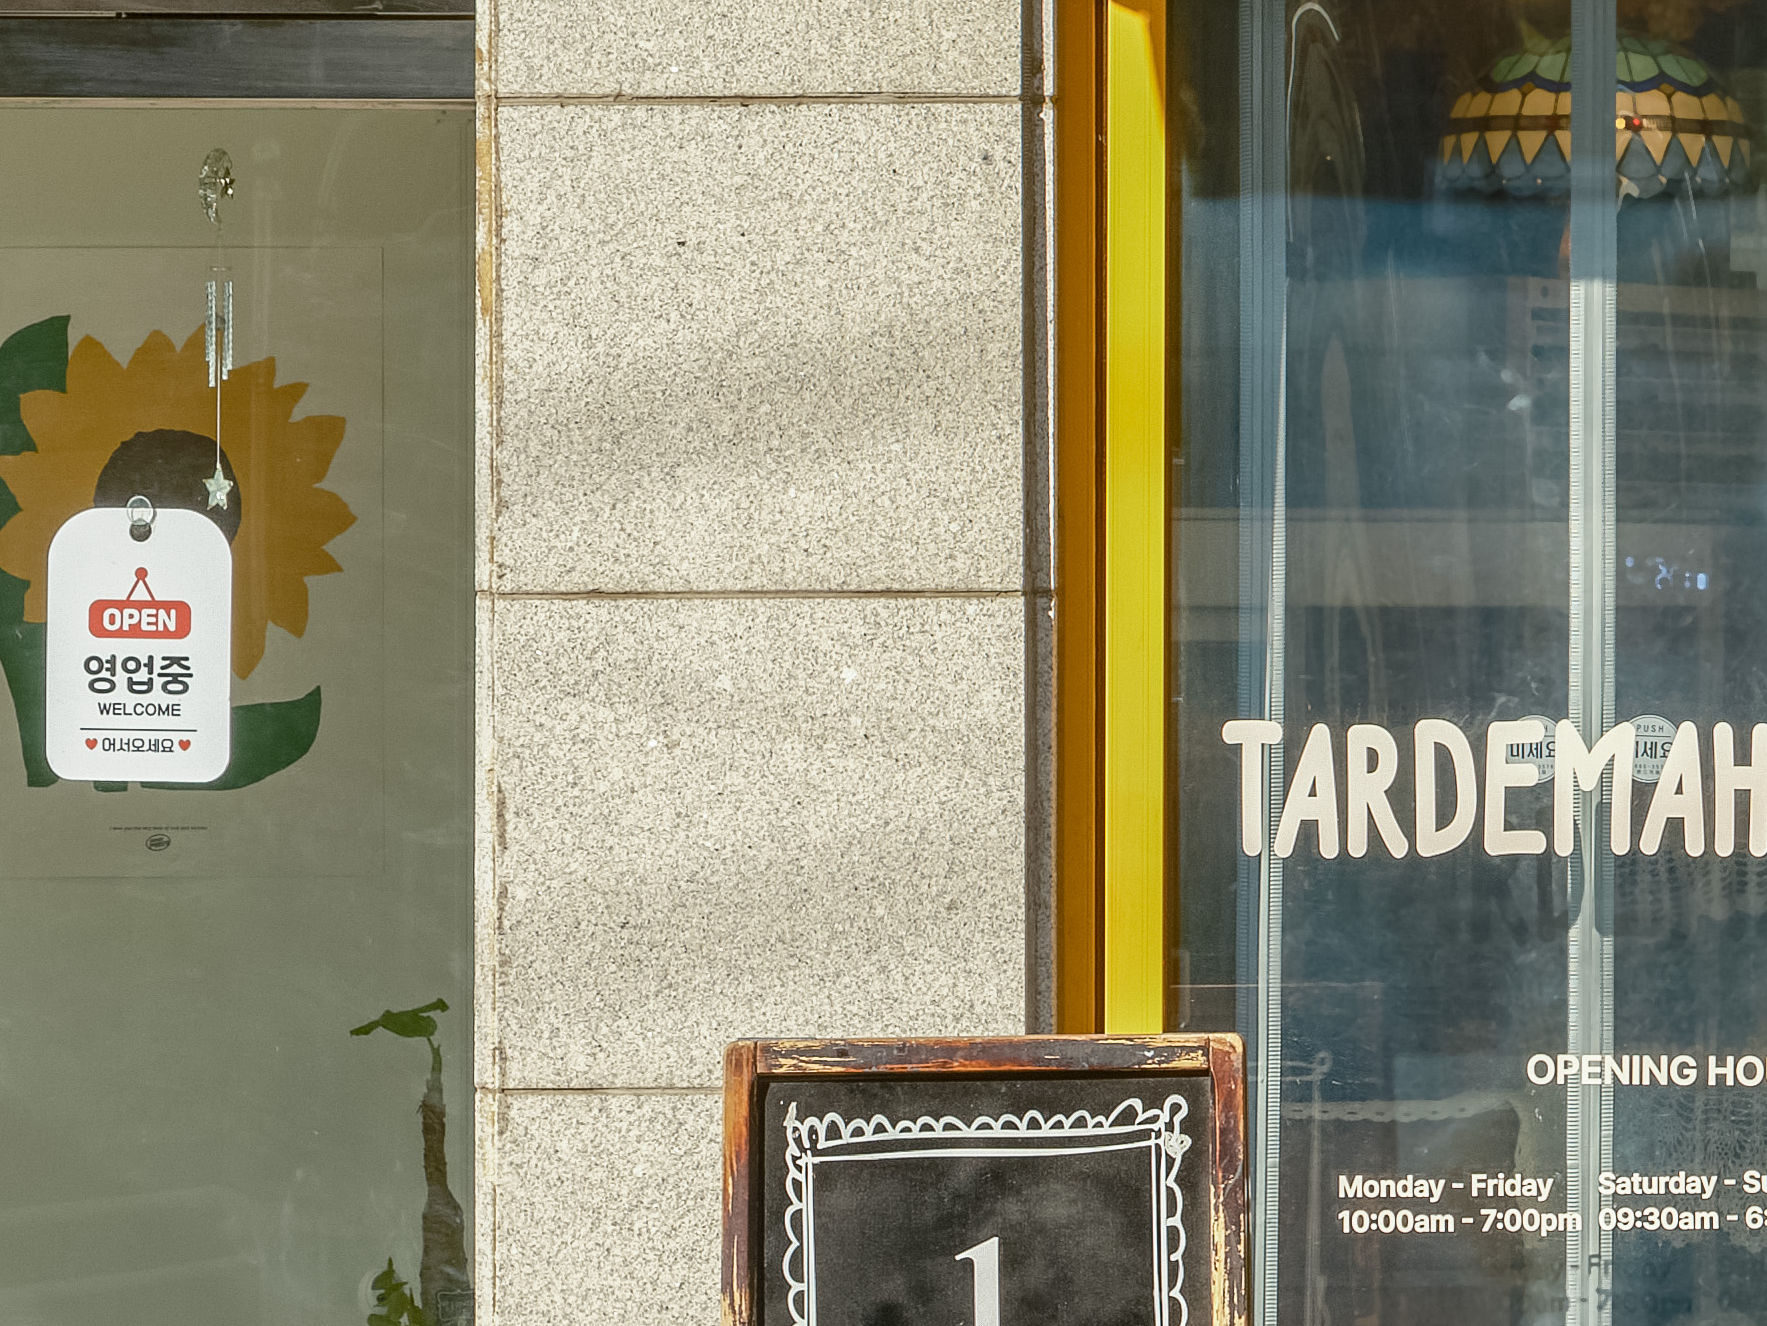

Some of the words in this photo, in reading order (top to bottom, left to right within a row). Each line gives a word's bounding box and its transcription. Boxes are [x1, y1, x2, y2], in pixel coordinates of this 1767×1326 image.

[102, 607, 176, 632] OPEN
[83, 654, 194, 695] 영업중
[97, 701, 182, 717] WELCOME
[1636, 724, 1665, 733] PUSH
[101, 737, 175, 754] 어서오세요
[1526, 1053, 1698, 1086] OPENING
[1338, 1174, 1445, 1202] Monday
[1471, 1172, 1554, 1202] Friday
[1597, 1171, 1718, 1200] Saturday
[1338, 1209, 1455, 1234] 10:00am
[1480, 1208, 1583, 1234] 7:00pm
[1598, 1206, 1720, 1232] 09:30am
